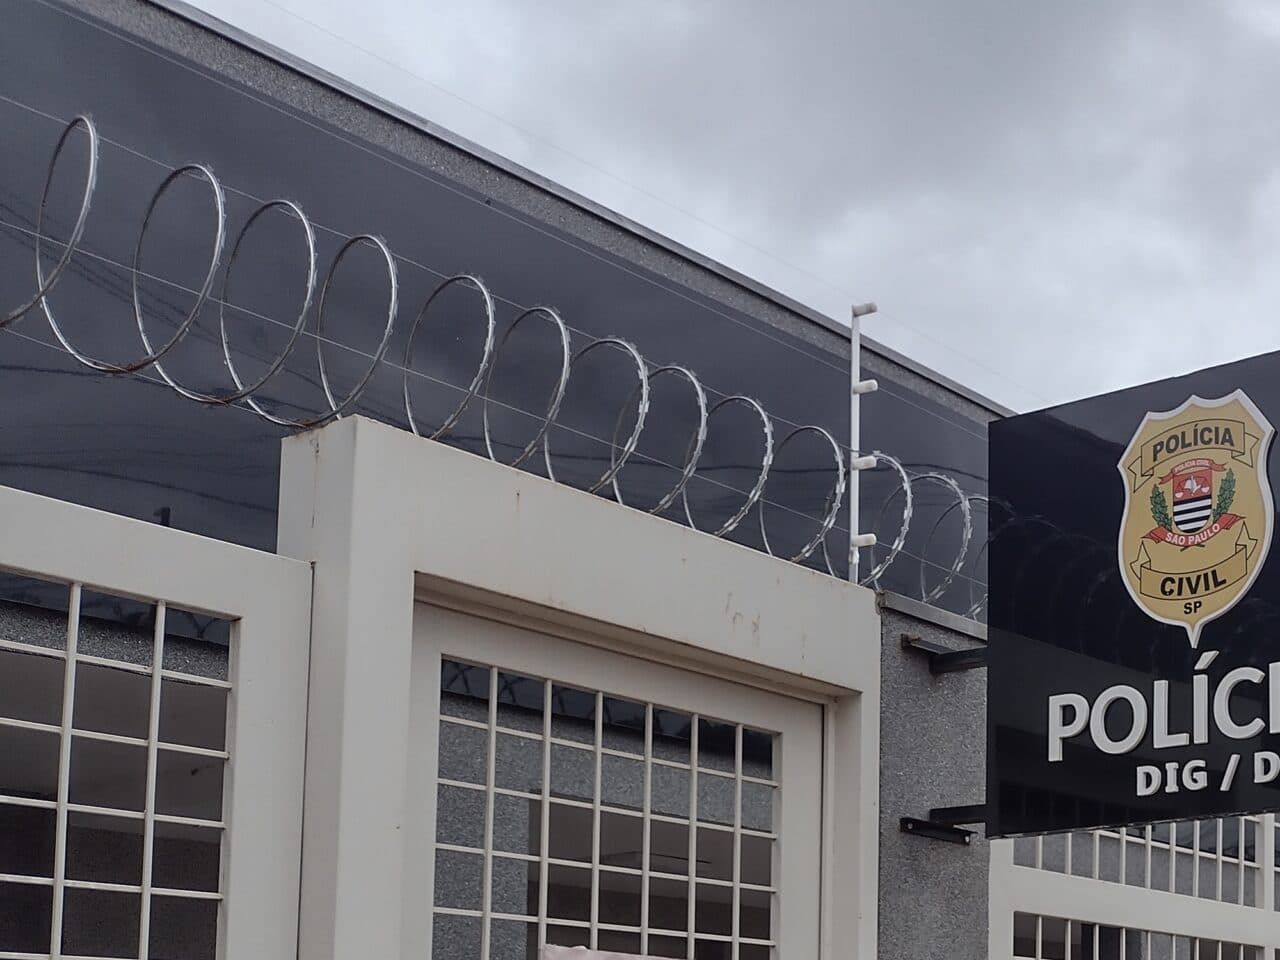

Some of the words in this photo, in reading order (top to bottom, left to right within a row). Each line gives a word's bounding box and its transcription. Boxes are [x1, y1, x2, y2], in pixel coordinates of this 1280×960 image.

[1152, 423, 1235, 463] POLÍCIA
[1188, 523, 1220, 545] PAULO
[1160, 569, 1227, 596] CIVIL
[1183, 601, 1202, 615] SP
[1136, 759, 1208, 797] DIG
[1219, 753, 1241, 792] /
